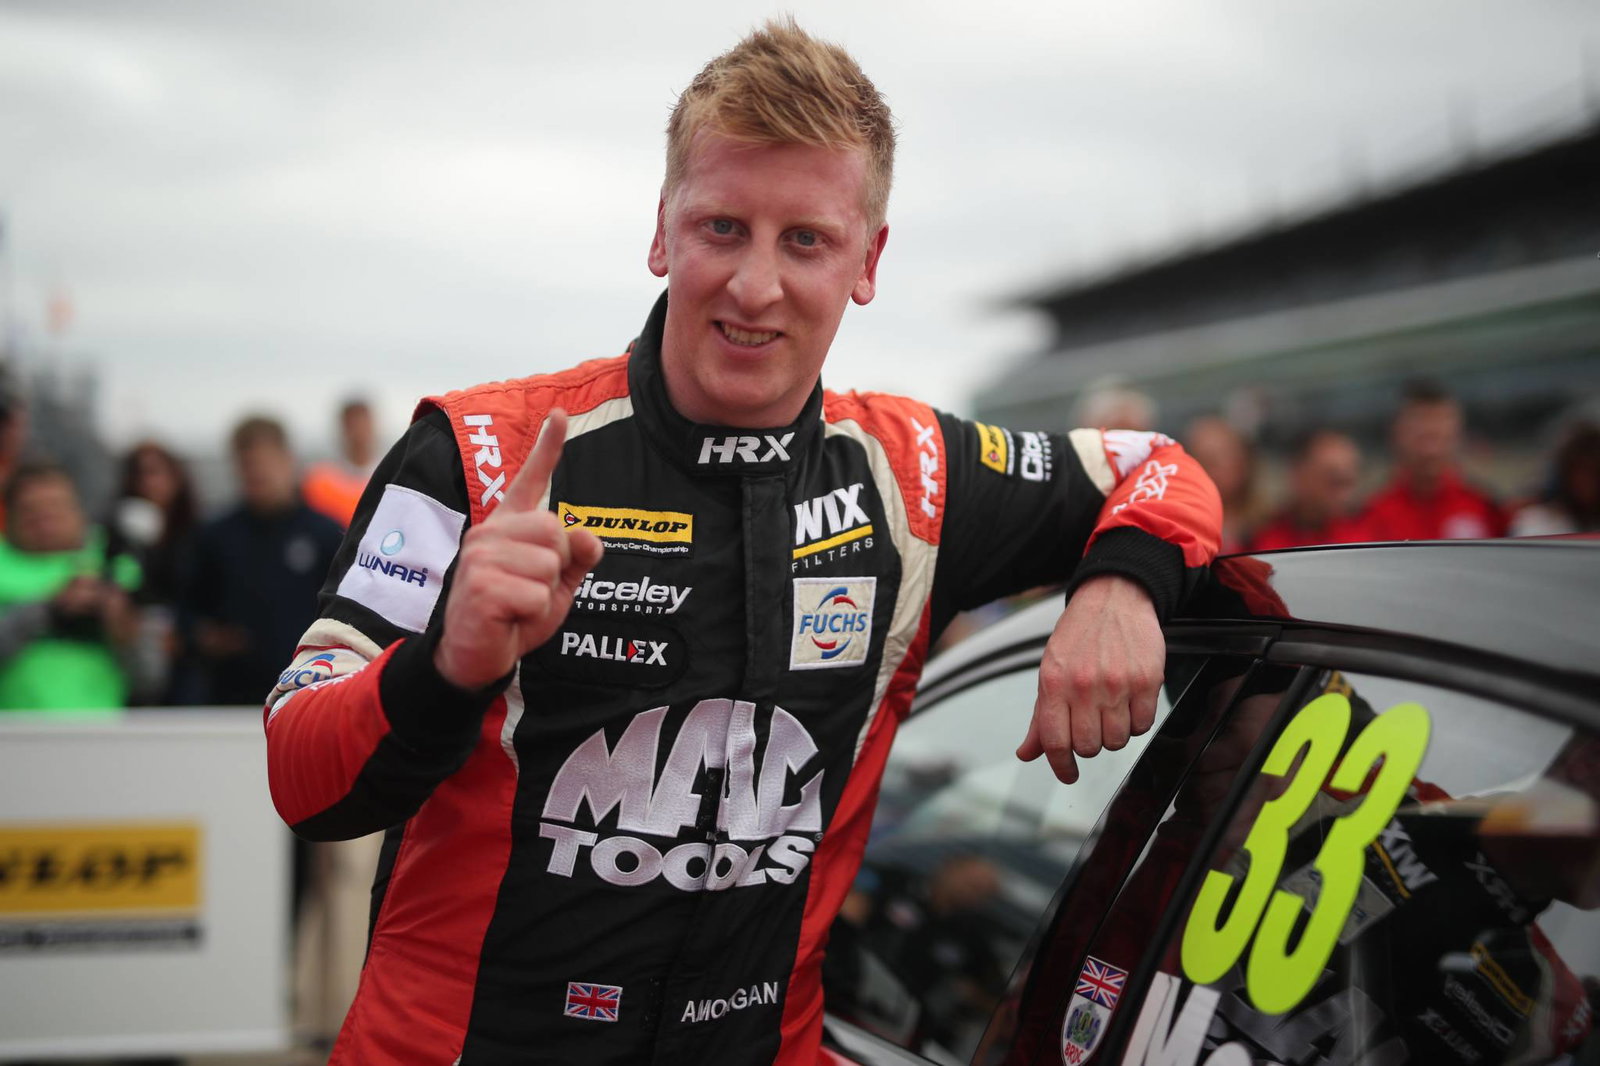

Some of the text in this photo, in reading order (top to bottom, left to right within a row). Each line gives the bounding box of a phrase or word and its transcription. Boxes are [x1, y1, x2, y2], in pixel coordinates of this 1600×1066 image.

[463, 414, 507, 507] HRX
[697, 431, 796, 464] HRX
[911, 417, 940, 519] HRX
[583, 516, 688, 533] DUNLOP
[794, 484, 871, 546] WIX
[643, 544, 689, 554] Championship
[791, 537, 874, 573] FILTERS
[358, 552, 427, 587] LUNAR
[576, 601, 663, 614] TORSPORT
[799, 612, 868, 635] FUCHS
[561, 632, 669, 668] PALLEX
[541, 698, 824, 840] MAC
[539, 822, 815, 892] TOOLS
[1181, 692, 1432, 1015] 33
